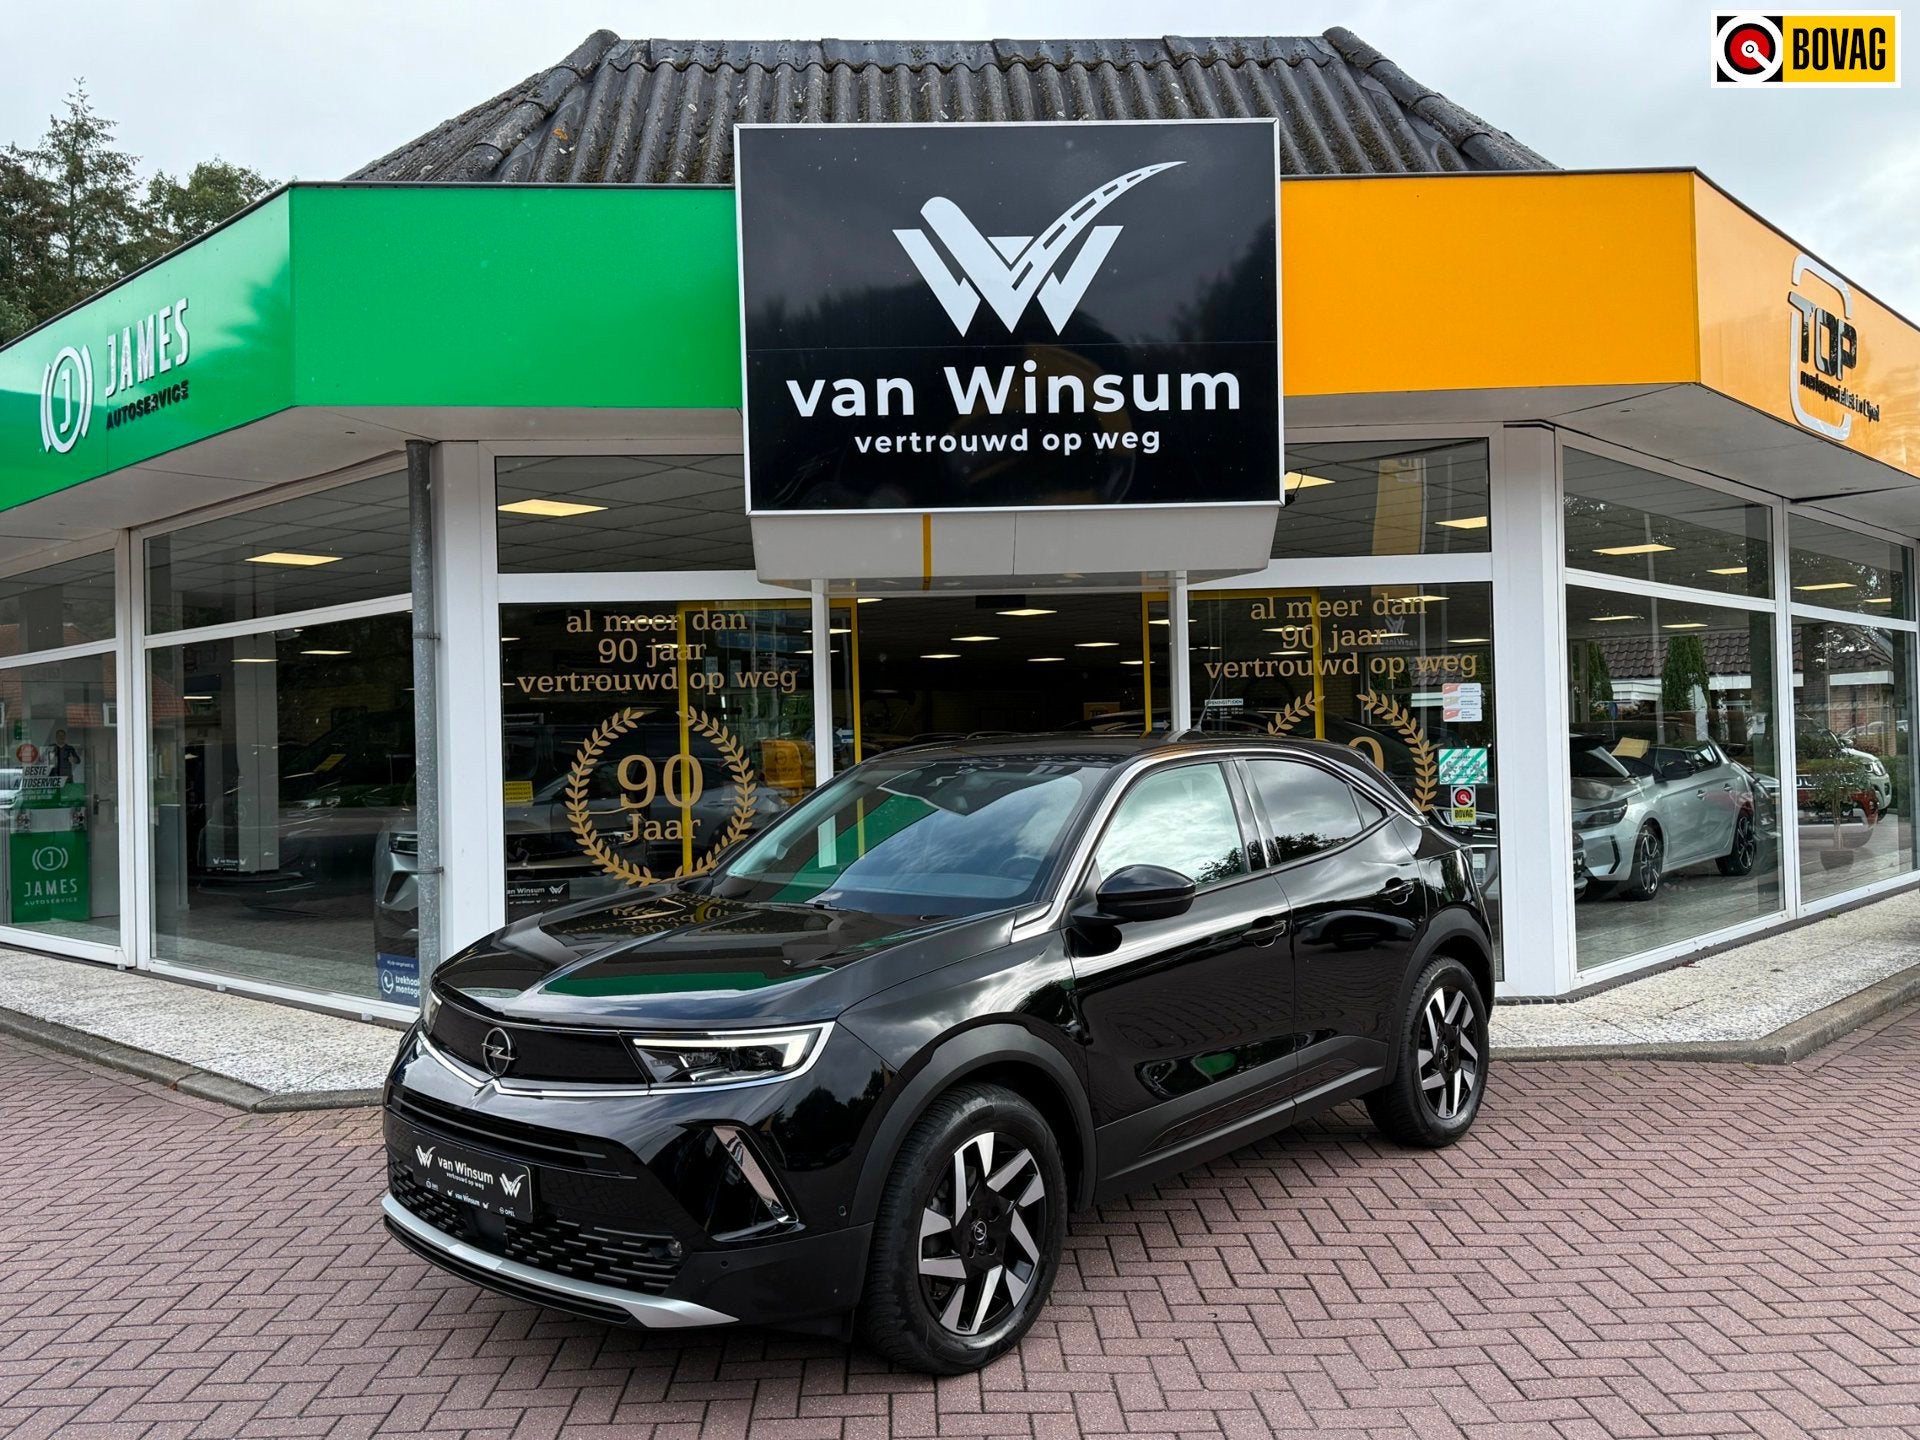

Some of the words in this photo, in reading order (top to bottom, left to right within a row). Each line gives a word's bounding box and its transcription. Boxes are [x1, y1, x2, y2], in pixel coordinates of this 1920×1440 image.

[105, 298, 189, 398] JAMES
[1787, 291, 1857, 381] TOP
[786, 377, 915, 417] van
[943, 359, 1240, 415] Winsum
[106, 381, 189, 430] AUTOSERVICE
[854, 428, 1028, 453] vertrouwd
[1042, 432, 1082, 456] op
[1093, 430, 1160, 454] weg
[566, 609, 593, 633] al
[603, 613, 681, 632] meer
[692, 607, 748, 631] dan
[1250, 596, 1276, 620] al
[1286, 599, 1363, 619] meer
[1372, 592, 1427, 616] dan
[598, 638, 638, 663] 90
[646, 638, 707, 668] jaar
[1281, 624, 1320, 649] 90
[1328, 624, 1388, 653] jaar
[517, 666, 680, 693] vertrouwd
[689, 671, 725, 695] op
[735, 669, 798, 694] weg
[1204, 652, 1361, 679] vertrouwd
[1370, 656, 1405, 680] op
[1415, 653, 1478, 678] weg
[25, 766, 47, 776] BESTE
[617, 753, 704, 809] 90
[623, 813, 701, 842] Jaar
[1455, 808, 1475, 819] BOVAG
[24, 878, 78, 898] JAMES
[24, 896, 78, 906] AUTOSERVICE
[516, 886, 546, 895] Winsum
[437, 1156, 454, 1172] van
[454, 1160, 494, 1185] Winsum
